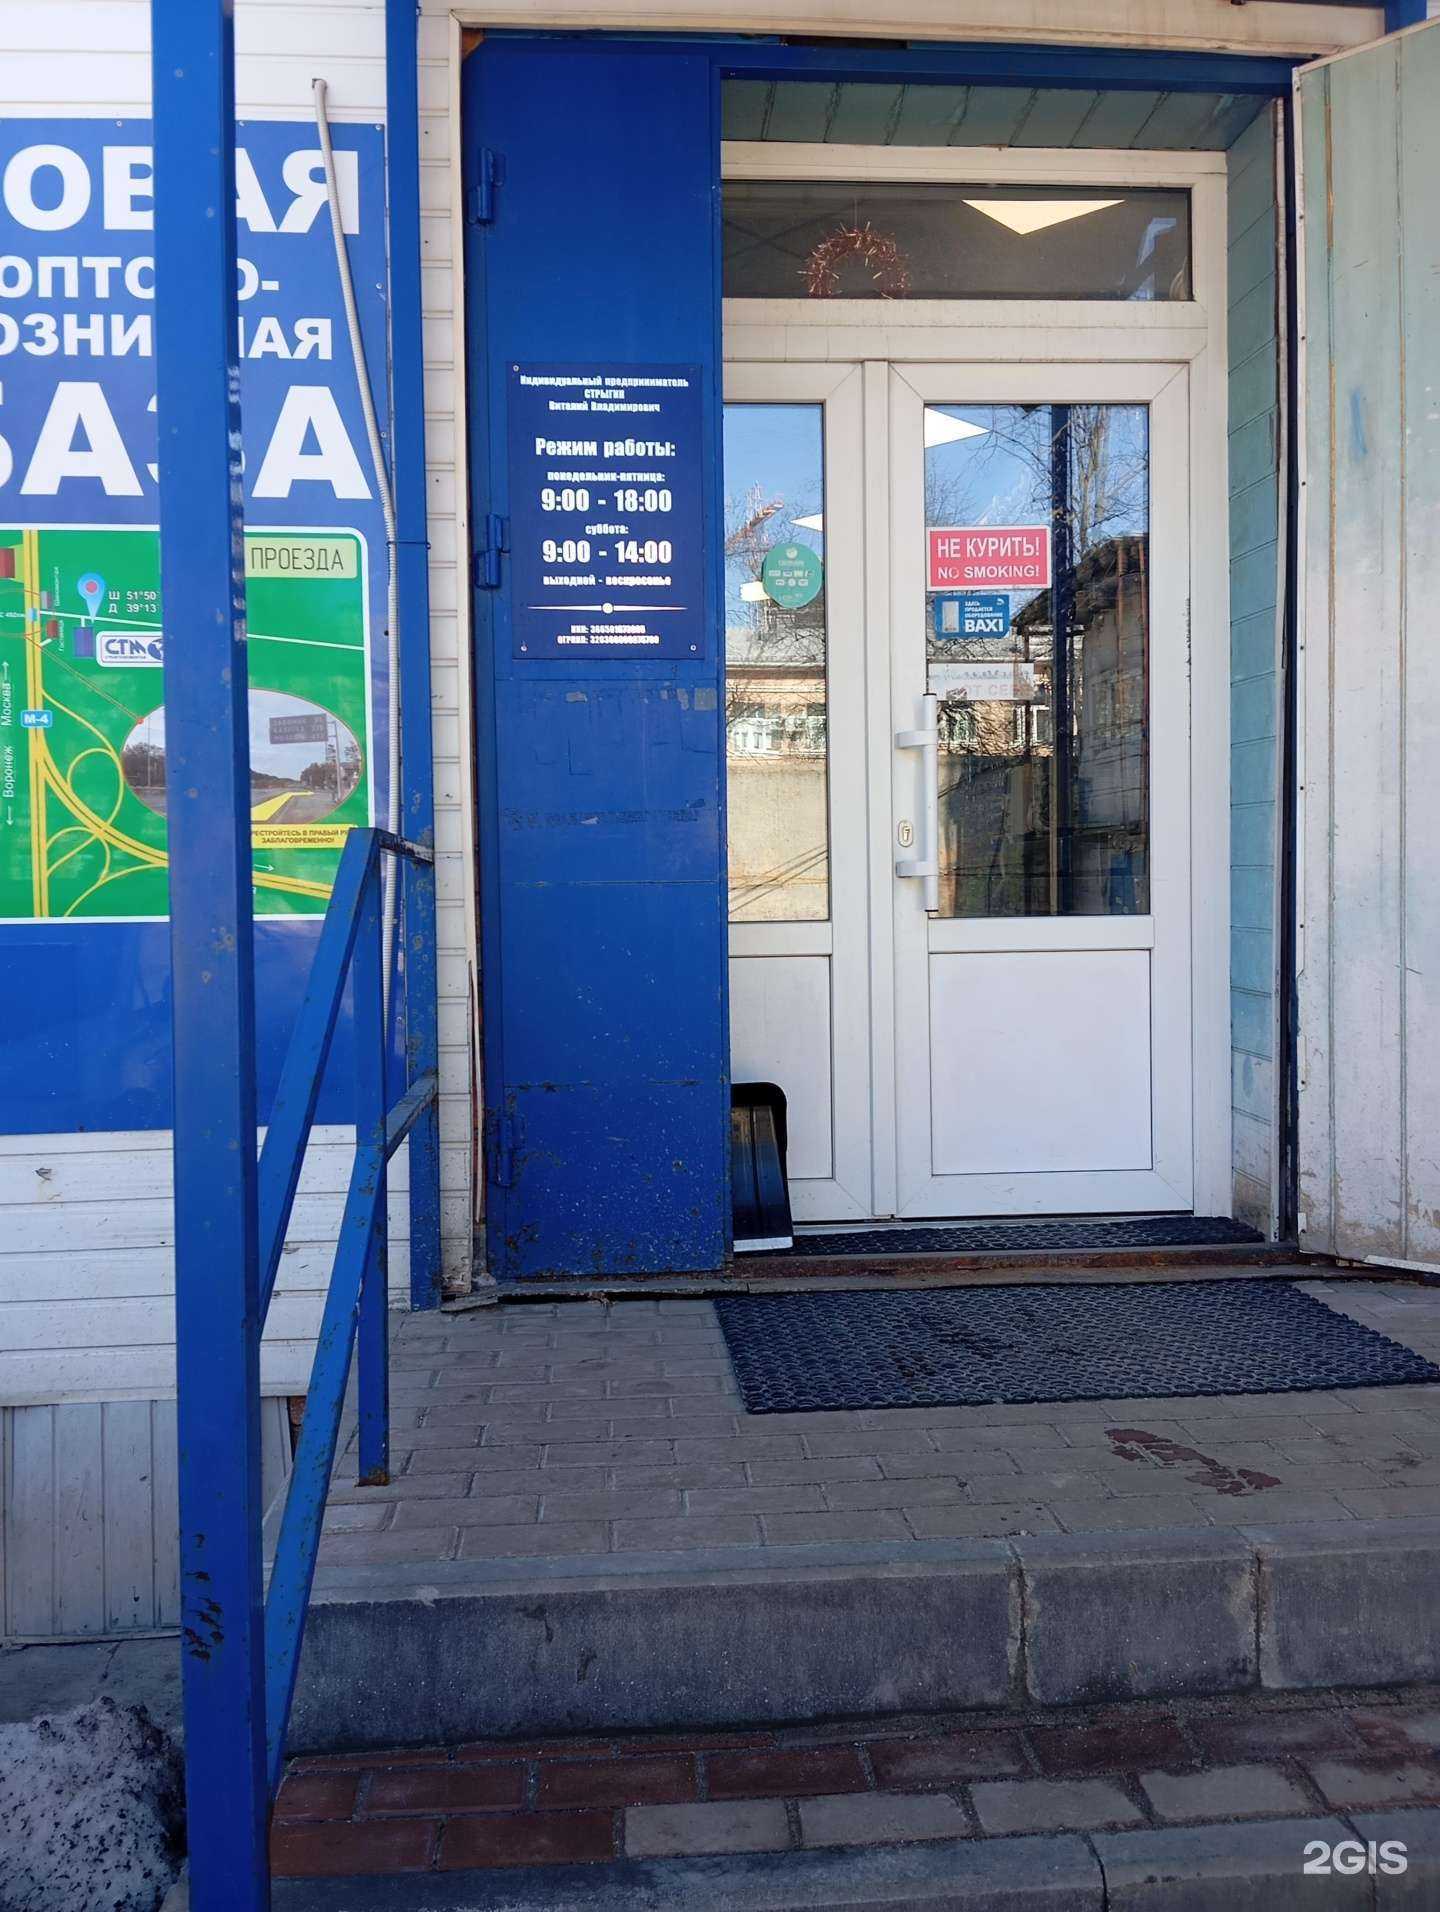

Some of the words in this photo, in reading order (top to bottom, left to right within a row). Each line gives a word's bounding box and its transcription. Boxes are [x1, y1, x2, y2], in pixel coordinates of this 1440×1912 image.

[536, 437, 598, 456] Режим
[603, 439, 676, 458] работы:
[541, 488, 590, 512] 9:00
[614, 489, 672, 512] 18:00
[585, 523, 629, 536] суббота:
[542, 540, 591, 563] 9:00
[614, 540, 672, 563] 14:00
[937, 538, 961, 558] НЕ
[966, 536, 1040, 558] КУРИТЬ!
[251, 547, 344, 571] ПРОЕЗДА
[543, 574, 596, 587] выходной
[938, 566, 960, 579] NO
[964, 564, 1040, 578] SMOKING!
[108, 591, 120, 600] Ш
[108, 603, 118, 613] Д
[964, 618, 1004, 633] BAXI
[1, 682, 12, 726] Москва
[24, 713, 49, 724] М-4
[3, 745, 15, 798] Воронеж
